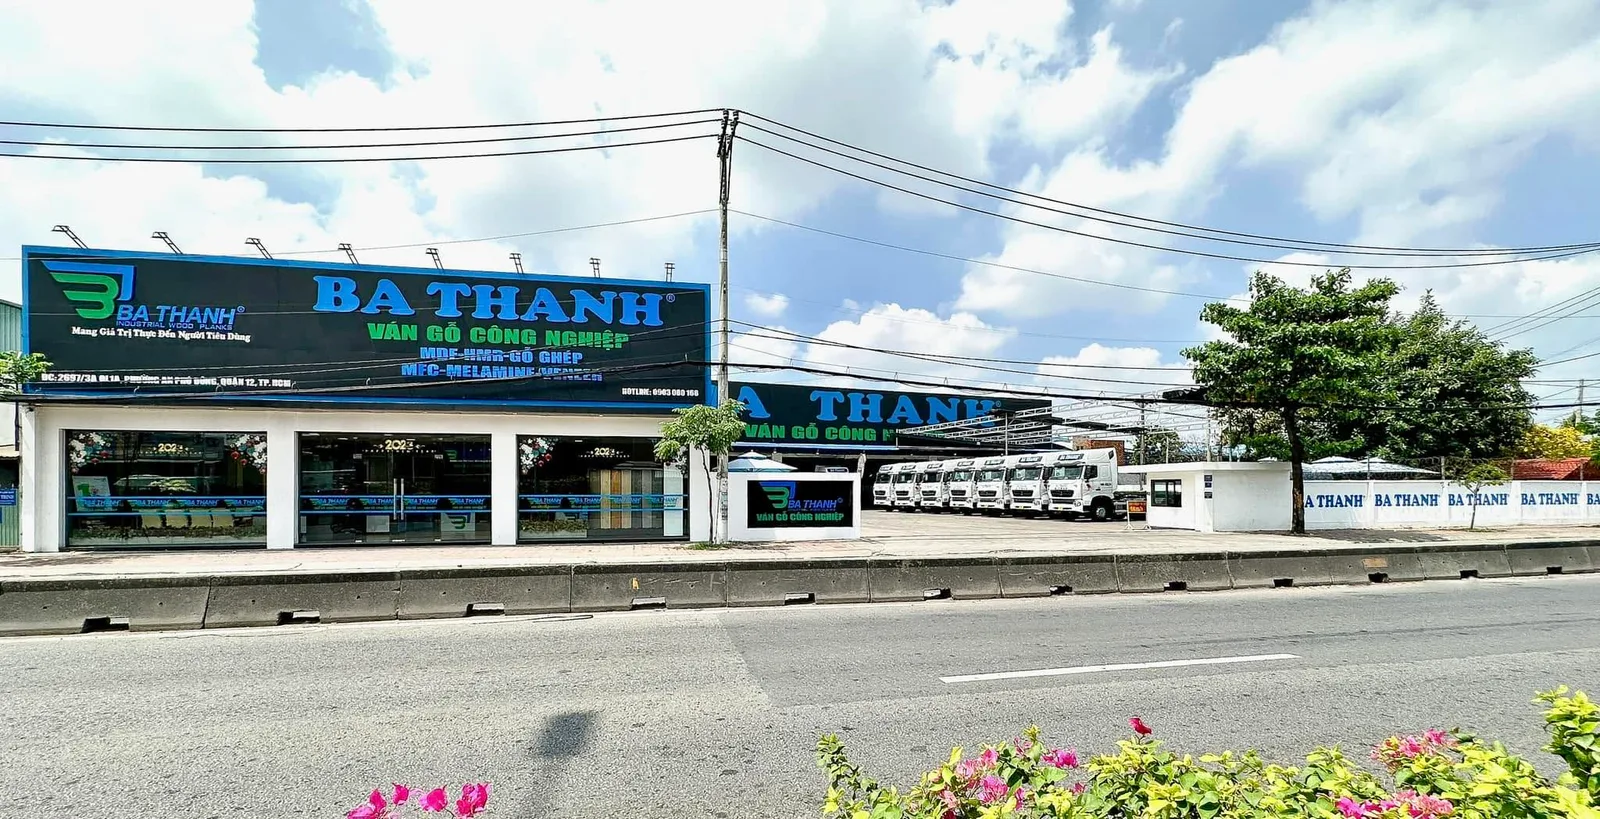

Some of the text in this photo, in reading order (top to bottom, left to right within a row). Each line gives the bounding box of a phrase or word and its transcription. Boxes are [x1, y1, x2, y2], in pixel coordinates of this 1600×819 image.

[313, 275, 416, 315] BA
[117, 304, 149, 322] BA
[116, 320, 166, 328] INDUSTRIAL
[71, 326, 251, 343] Mang Giá Trị Thực Đến Người Tiêu Dùng
[367, 321, 629, 350] VÁN GỖ CÔNG NGHIỆP
[539, 350, 583, 364] GHÉP
[744, 422, 785, 438] VÁN
[791, 423, 819, 439] GỖ
[825, 425, 877, 441] CÔNG
[788, 500, 801, 509] BA
[1316, 494, 1363, 508] THANH
[1374, 493, 1439, 507] BA THANH
[1448, 493, 1508, 506] BA THANH
[1521, 492, 1579, 505] BA THANH
